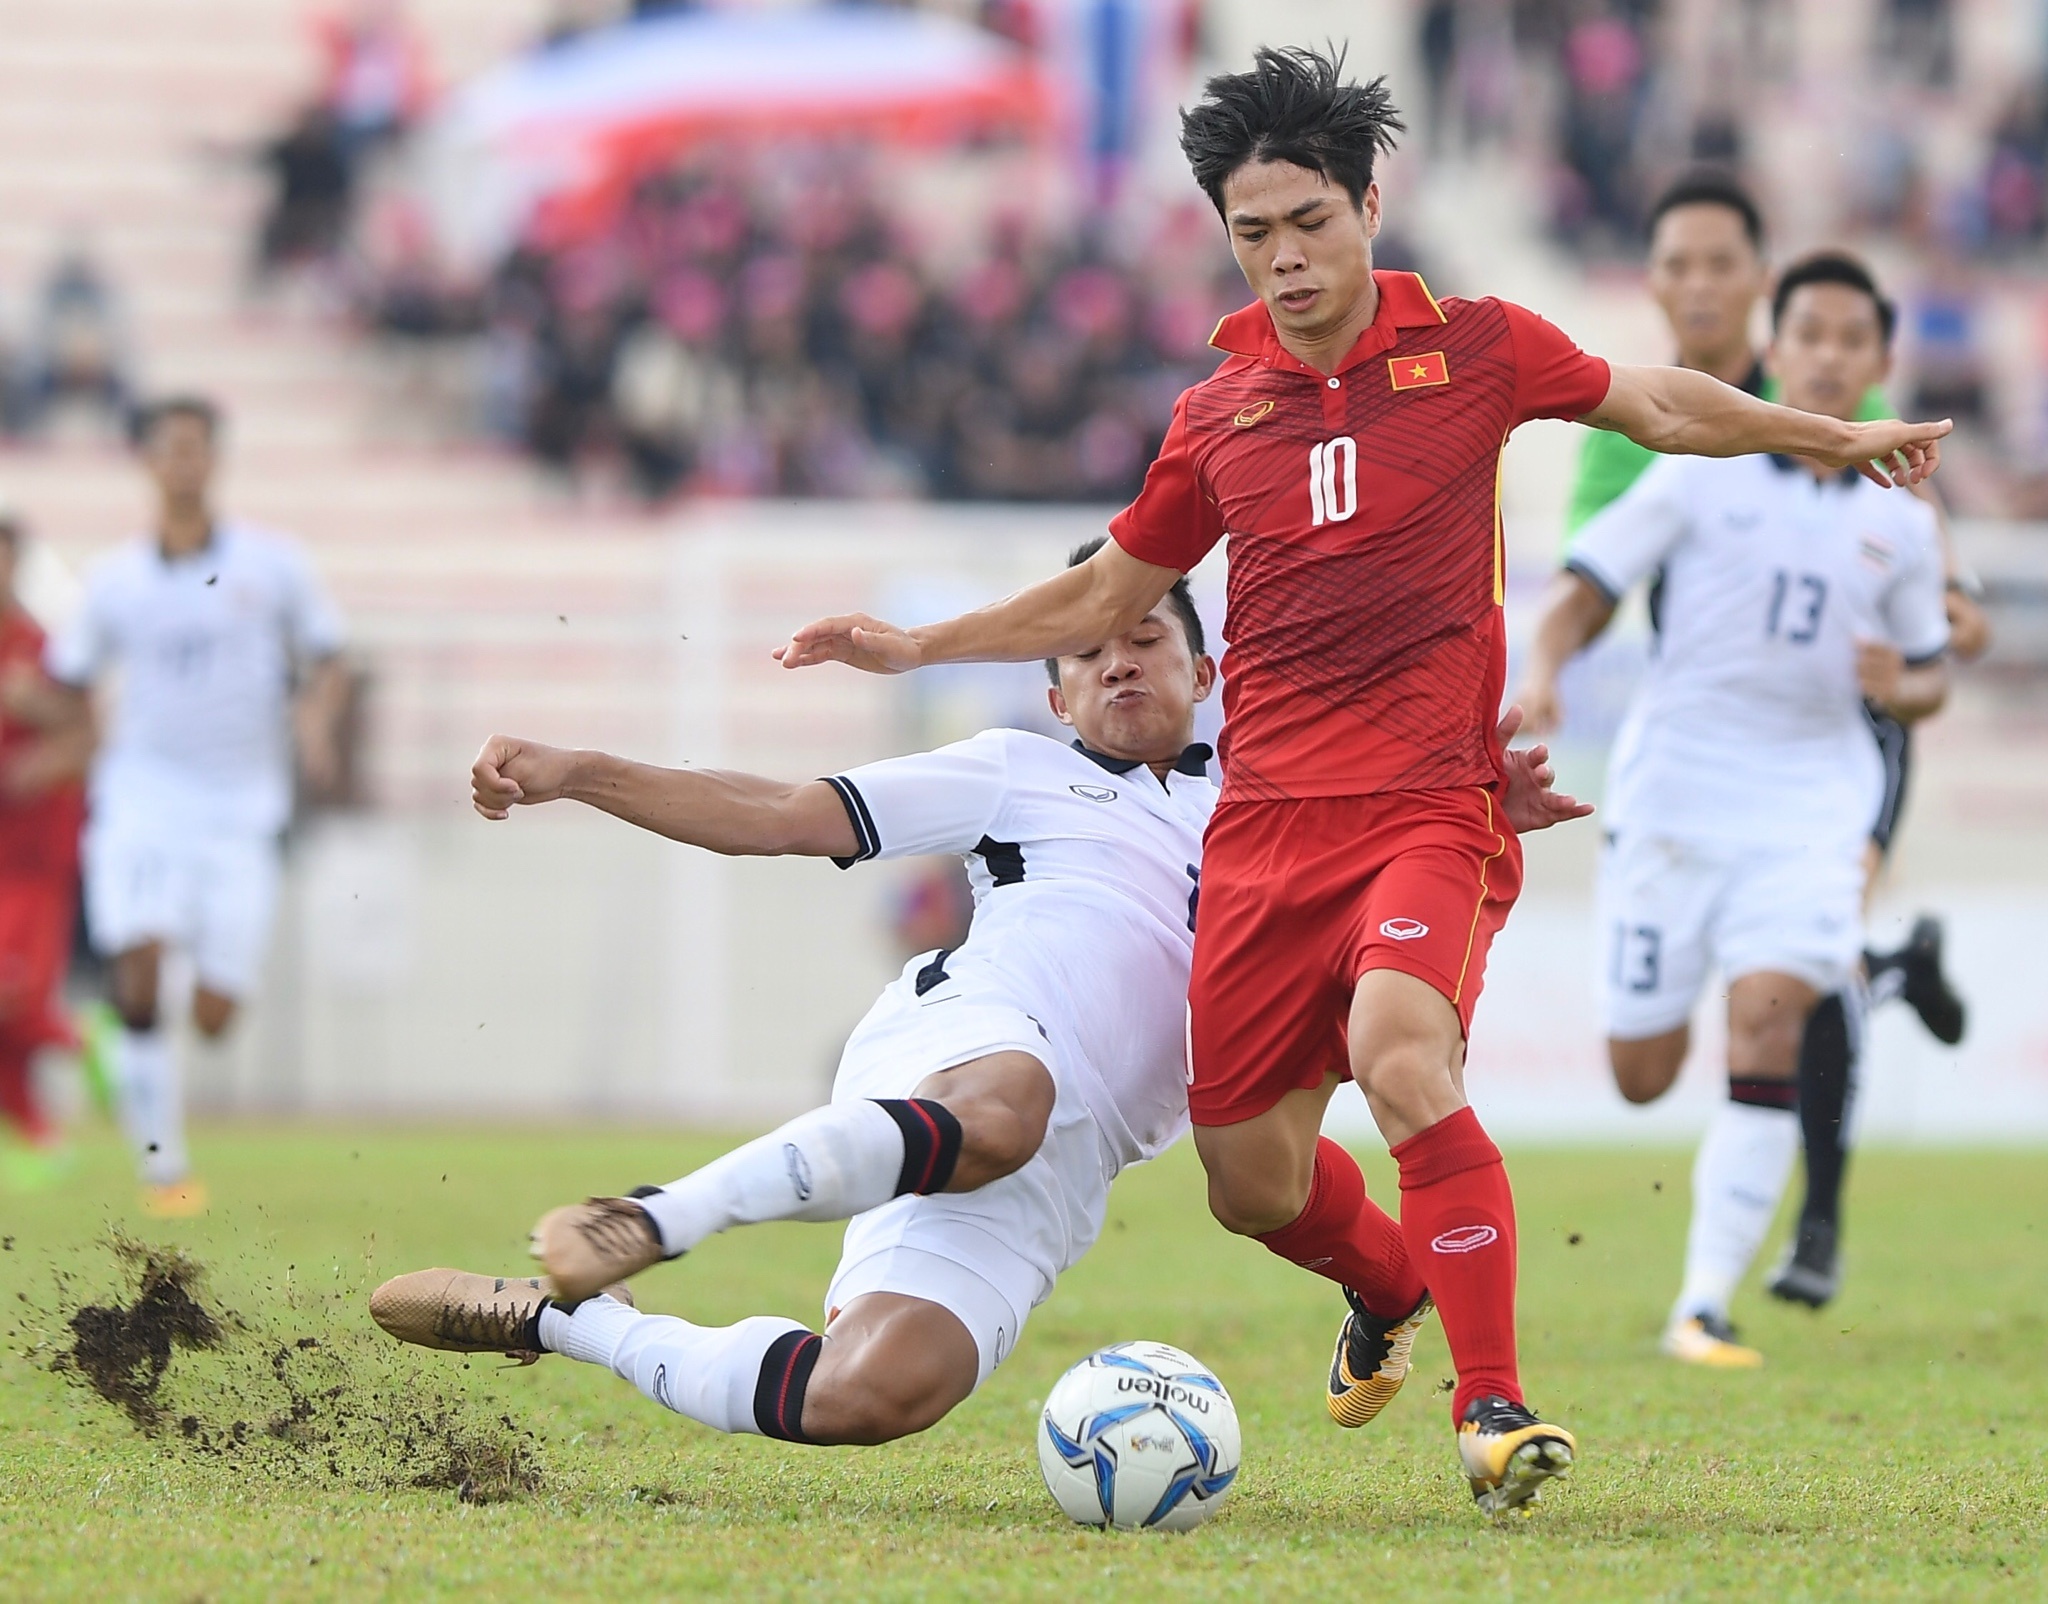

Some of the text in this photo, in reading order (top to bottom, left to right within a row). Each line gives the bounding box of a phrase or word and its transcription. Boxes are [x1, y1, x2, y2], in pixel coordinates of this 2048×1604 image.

[1309, 436, 1357, 526] 10
[1766, 568, 1828, 645] 13
[1611, 920, 1661, 994] 13
[1117, 1376, 1210, 1414] molten
